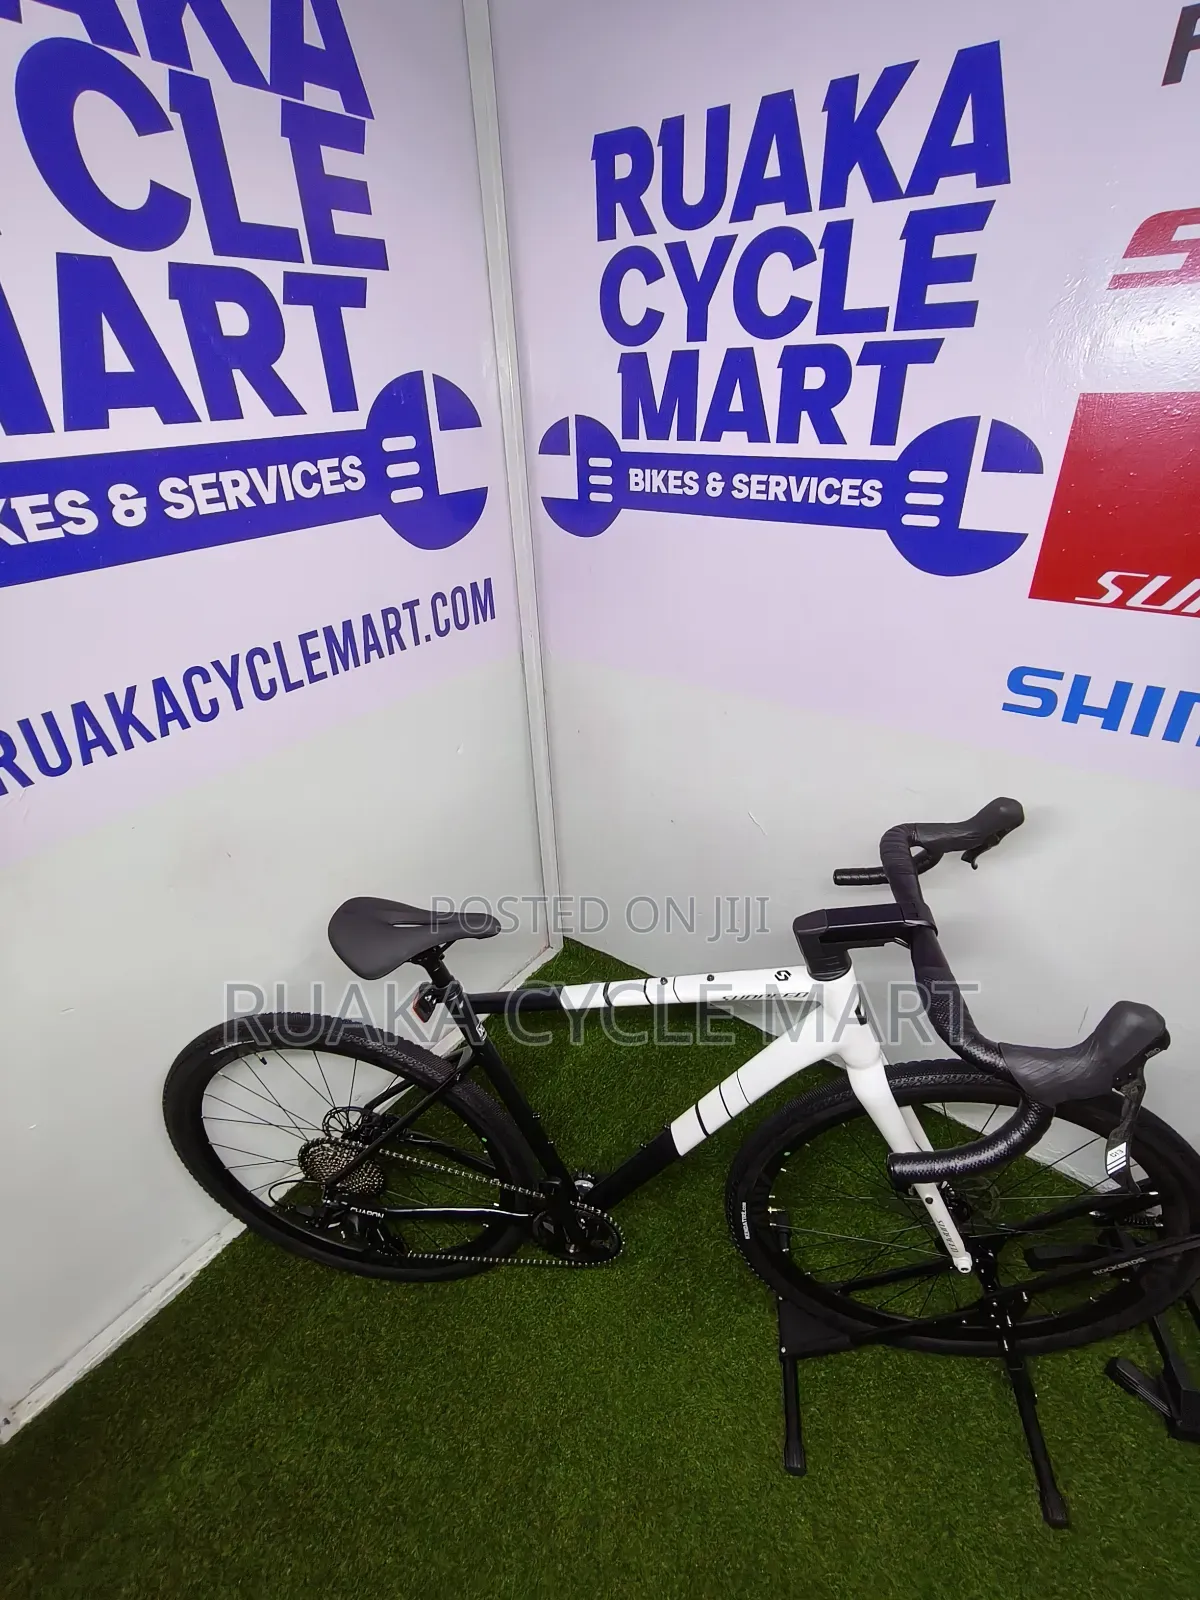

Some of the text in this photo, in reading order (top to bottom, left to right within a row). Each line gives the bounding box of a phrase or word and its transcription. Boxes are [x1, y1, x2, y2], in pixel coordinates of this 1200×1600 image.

[590, 40, 1011, 241] RUAKA
[599, 199, 997, 347] CYCLE
[617, 338, 945, 447] MART
[107, 483, 147, 527] &
[158, 455, 366, 520] SERVICES
[628, 467, 883, 508] BIKES & SERVICES
[0, 577, 497, 796] RUAKACYCLEMART.COM
